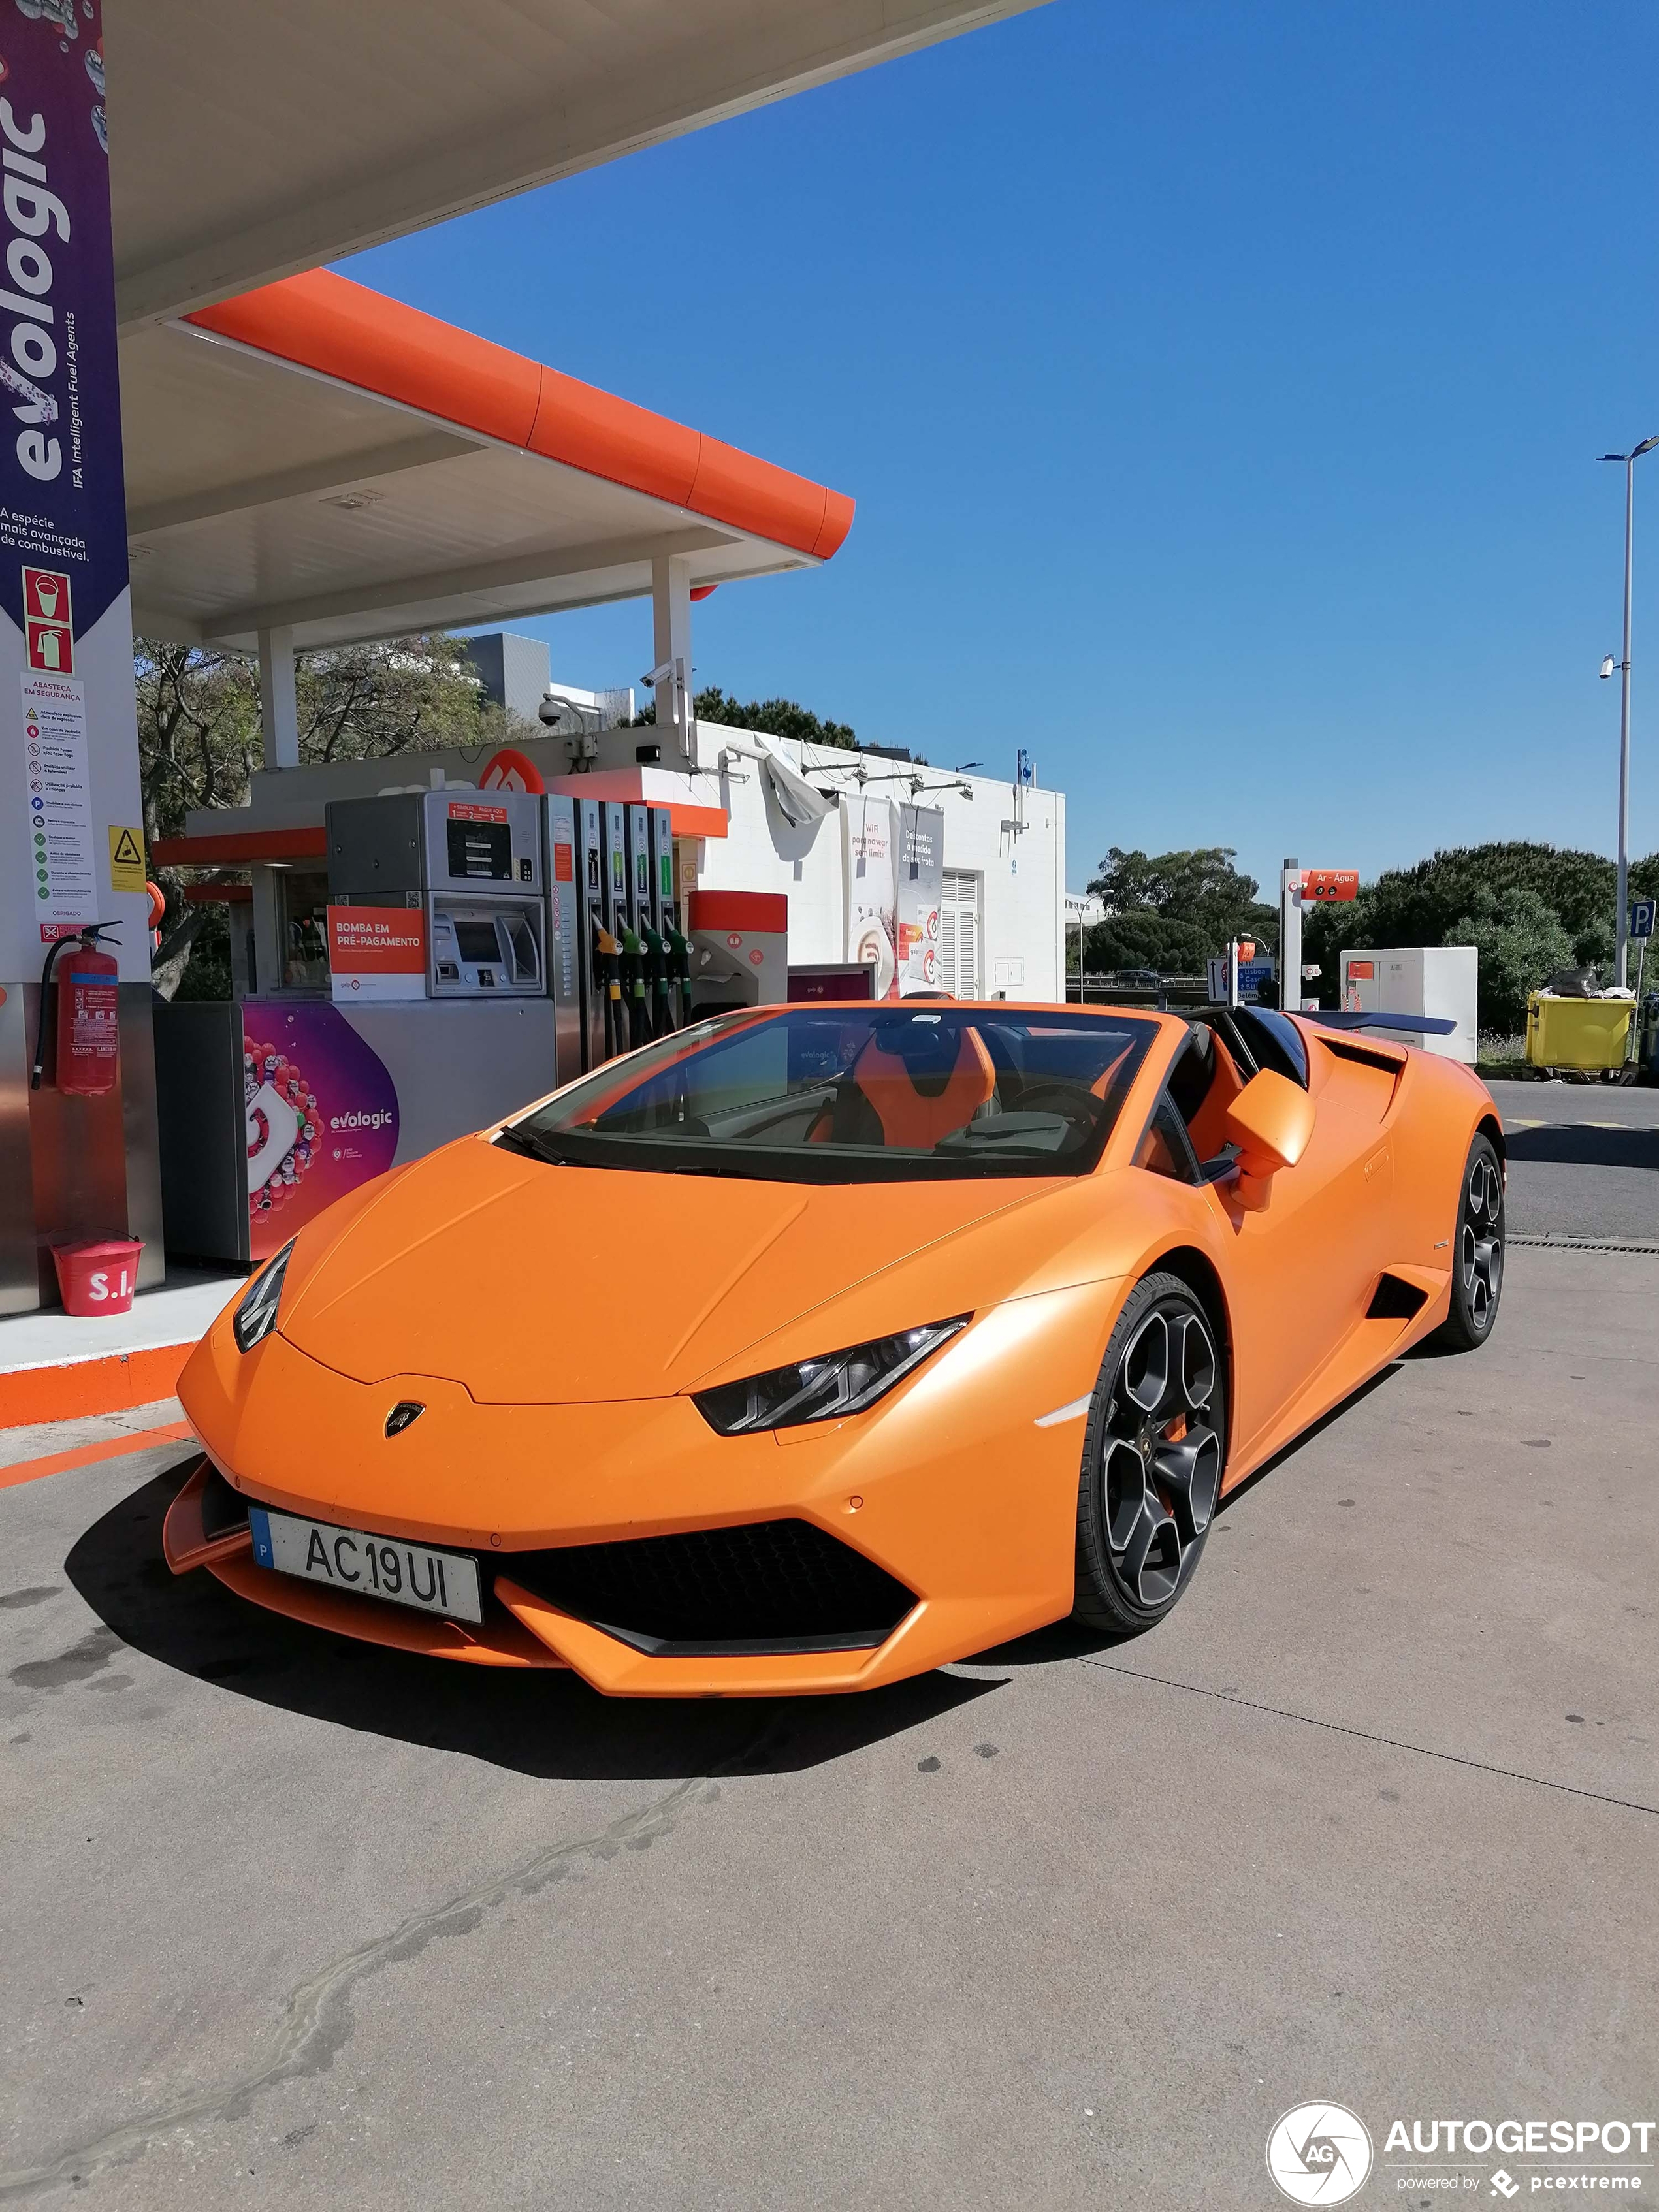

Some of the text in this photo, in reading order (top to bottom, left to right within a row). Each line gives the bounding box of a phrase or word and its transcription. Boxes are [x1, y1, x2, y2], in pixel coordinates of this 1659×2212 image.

[0, 96, 71, 480] evologic
[66, 311, 83, 489] IFA Intelligent Fuel Agents
[0, 507, 55, 530] A espécie
[0, 522, 86, 549] mais avançada
[1, 534, 90, 562] de combustível.
[33, 681, 71, 692] ABASTEÇA
[37, 690, 80, 701] SEGURANÇA
[865, 823, 879, 833] WiFi
[905, 829, 933, 843] Descontos
[907, 842, 910, 851] à
[902, 853, 910, 863] da
[921, 856, 934, 867] frota
[1334, 873, 1355, 884] Água
[1635, 905, 1650, 934] P
[336, 922, 389, 933] BOMBA EM
[337, 934, 420, 946] PRÉ-PAGAMENTO
[330, 1108, 393, 1130] evologic
[89, 1270, 133, 1301] S.I.
[259, 1543, 268, 1557] P
[306, 1528, 361, 1582] AC
[365, 1542, 402, 1594] 19
